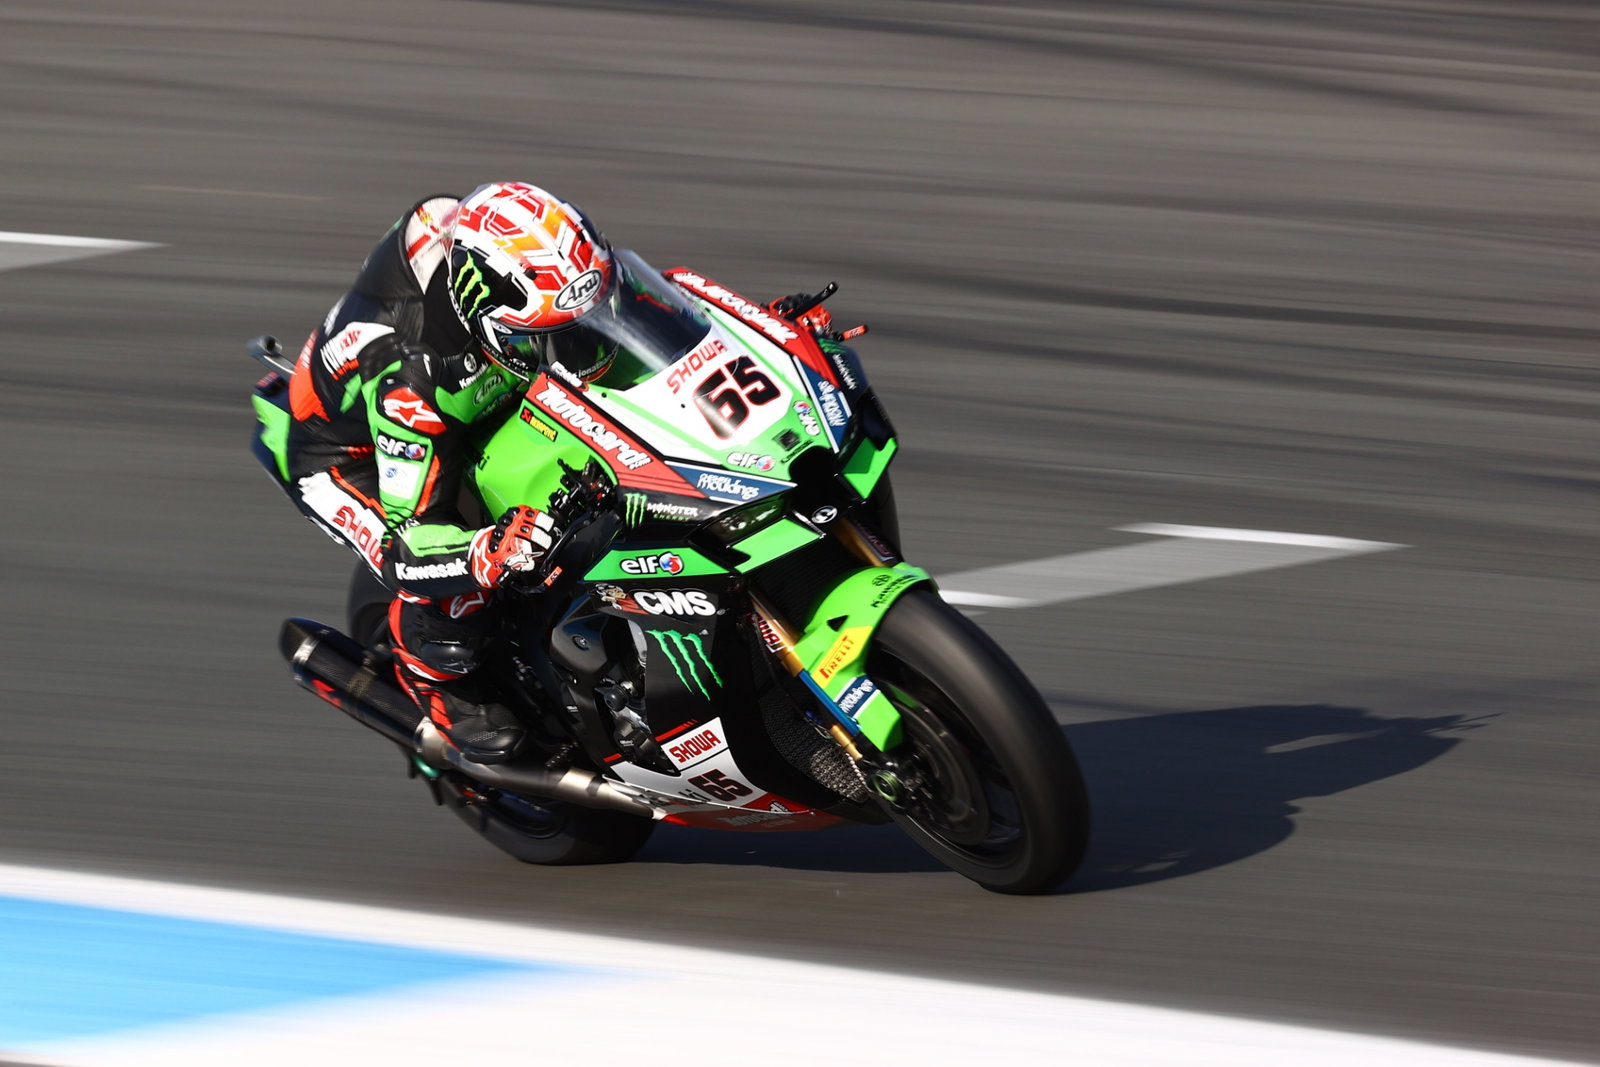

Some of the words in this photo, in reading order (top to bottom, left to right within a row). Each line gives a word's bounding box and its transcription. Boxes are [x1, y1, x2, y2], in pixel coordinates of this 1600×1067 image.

[560, 273, 598, 308] Arai
[667, 340, 728, 394] SHOWA
[692, 355, 782, 440] 65
[376, 435, 406, 456] elf
[727, 452, 760, 468] elf
[646, 502, 698, 517] MONSTER
[332, 505, 385, 571] SHOW
[394, 558, 469, 580] Kawasak
[620, 556, 659, 574] elf
[634, 591, 717, 616] CMS
[669, 729, 722, 763] SHOWA
[688, 768, 754, 802] 65
